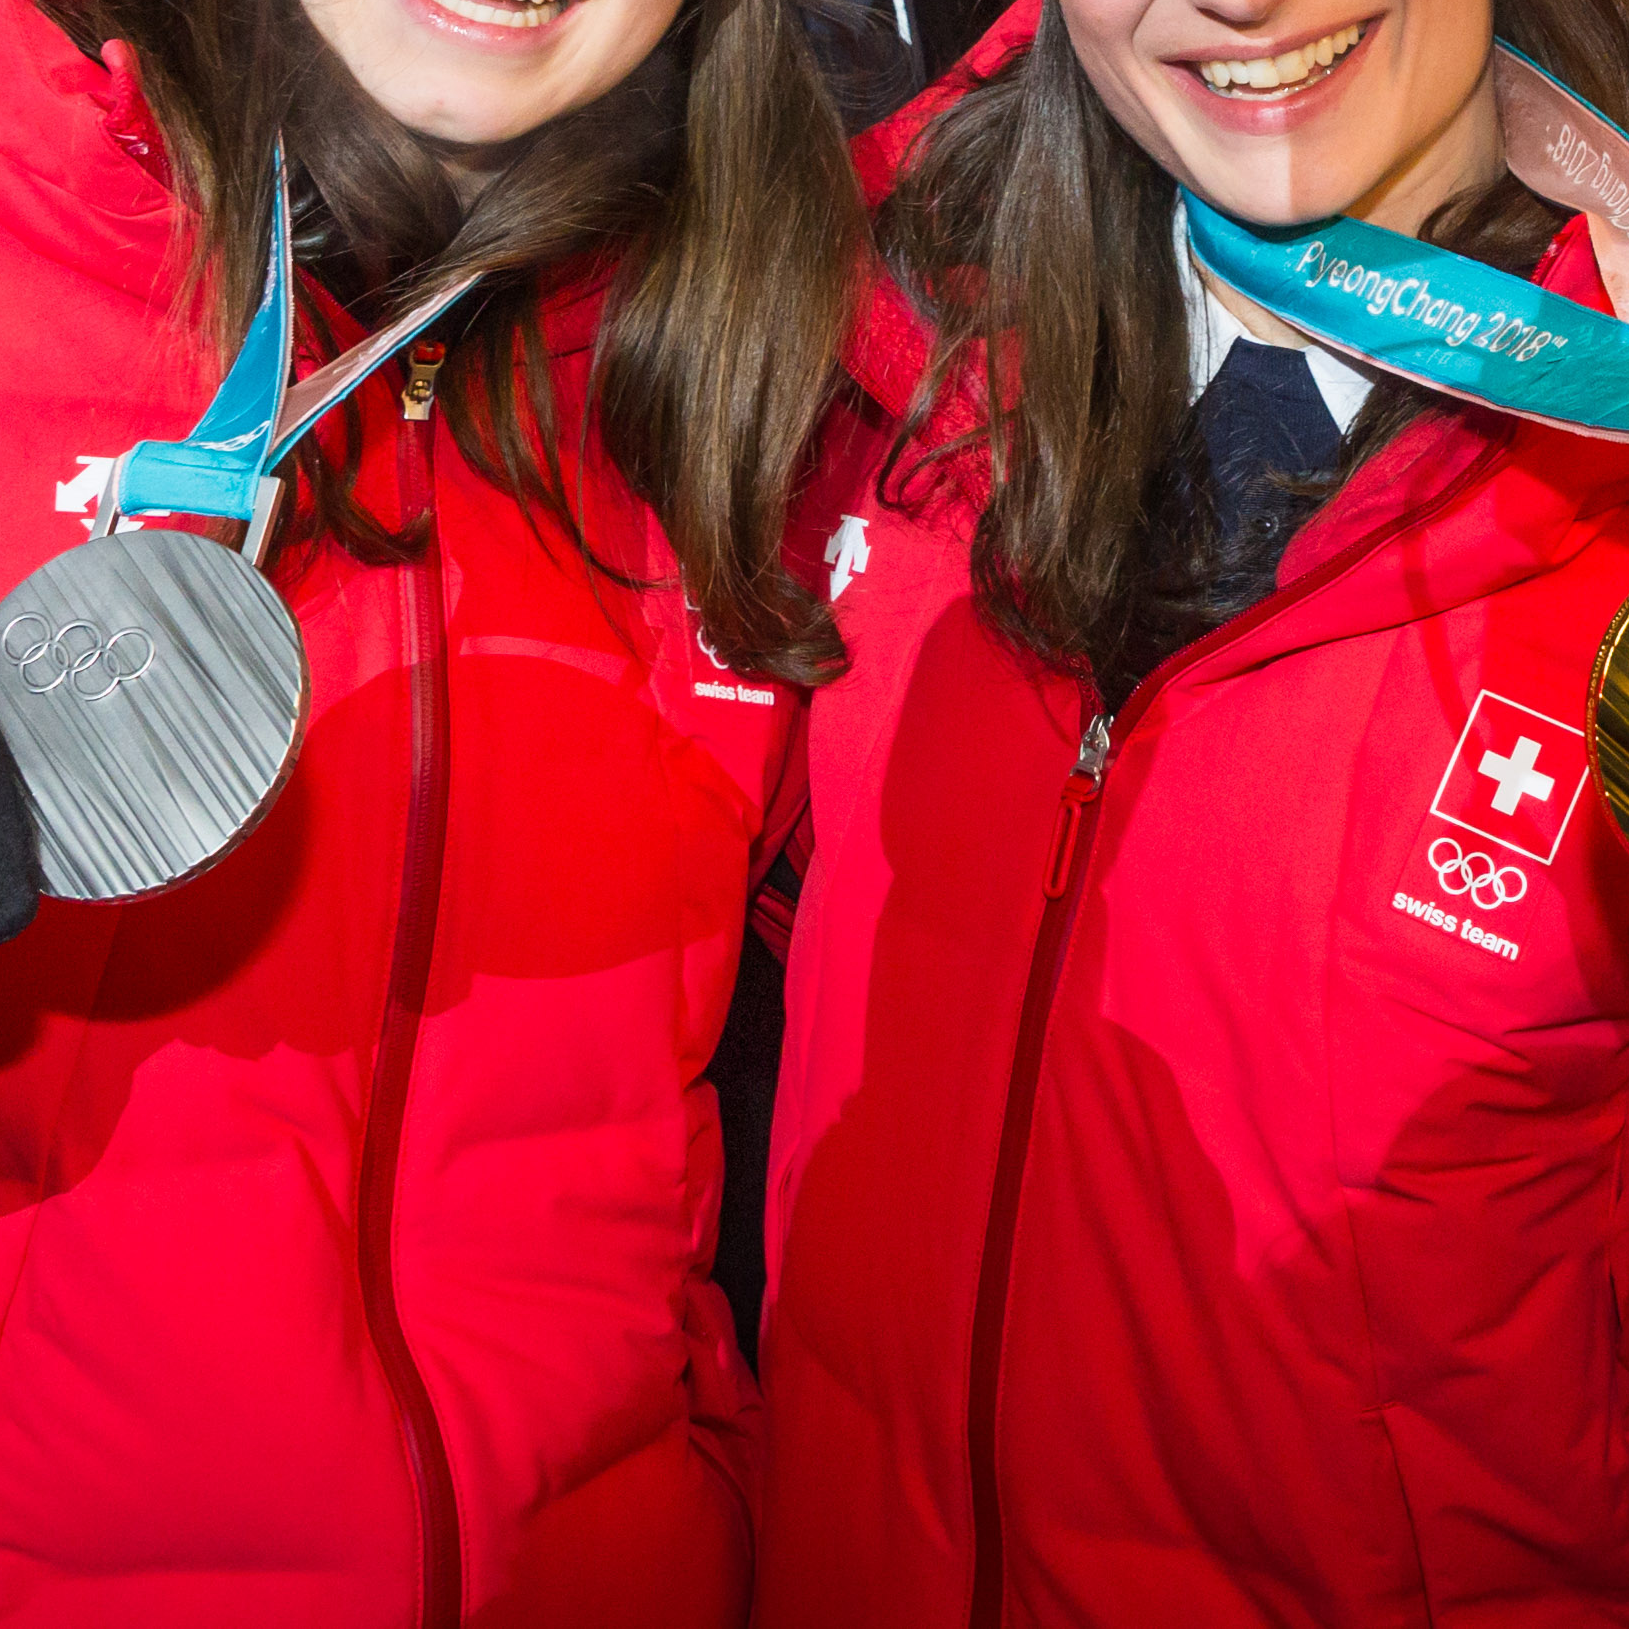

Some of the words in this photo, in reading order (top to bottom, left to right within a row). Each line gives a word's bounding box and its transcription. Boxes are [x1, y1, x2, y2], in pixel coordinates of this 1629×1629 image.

[1296, 240, 1481, 347] PyeongChang
[694, 681, 736, 701] swiss
[737, 684, 775, 706] team
[1392, 892, 1458, 932] swiss
[1460, 918, 1519, 961] team
